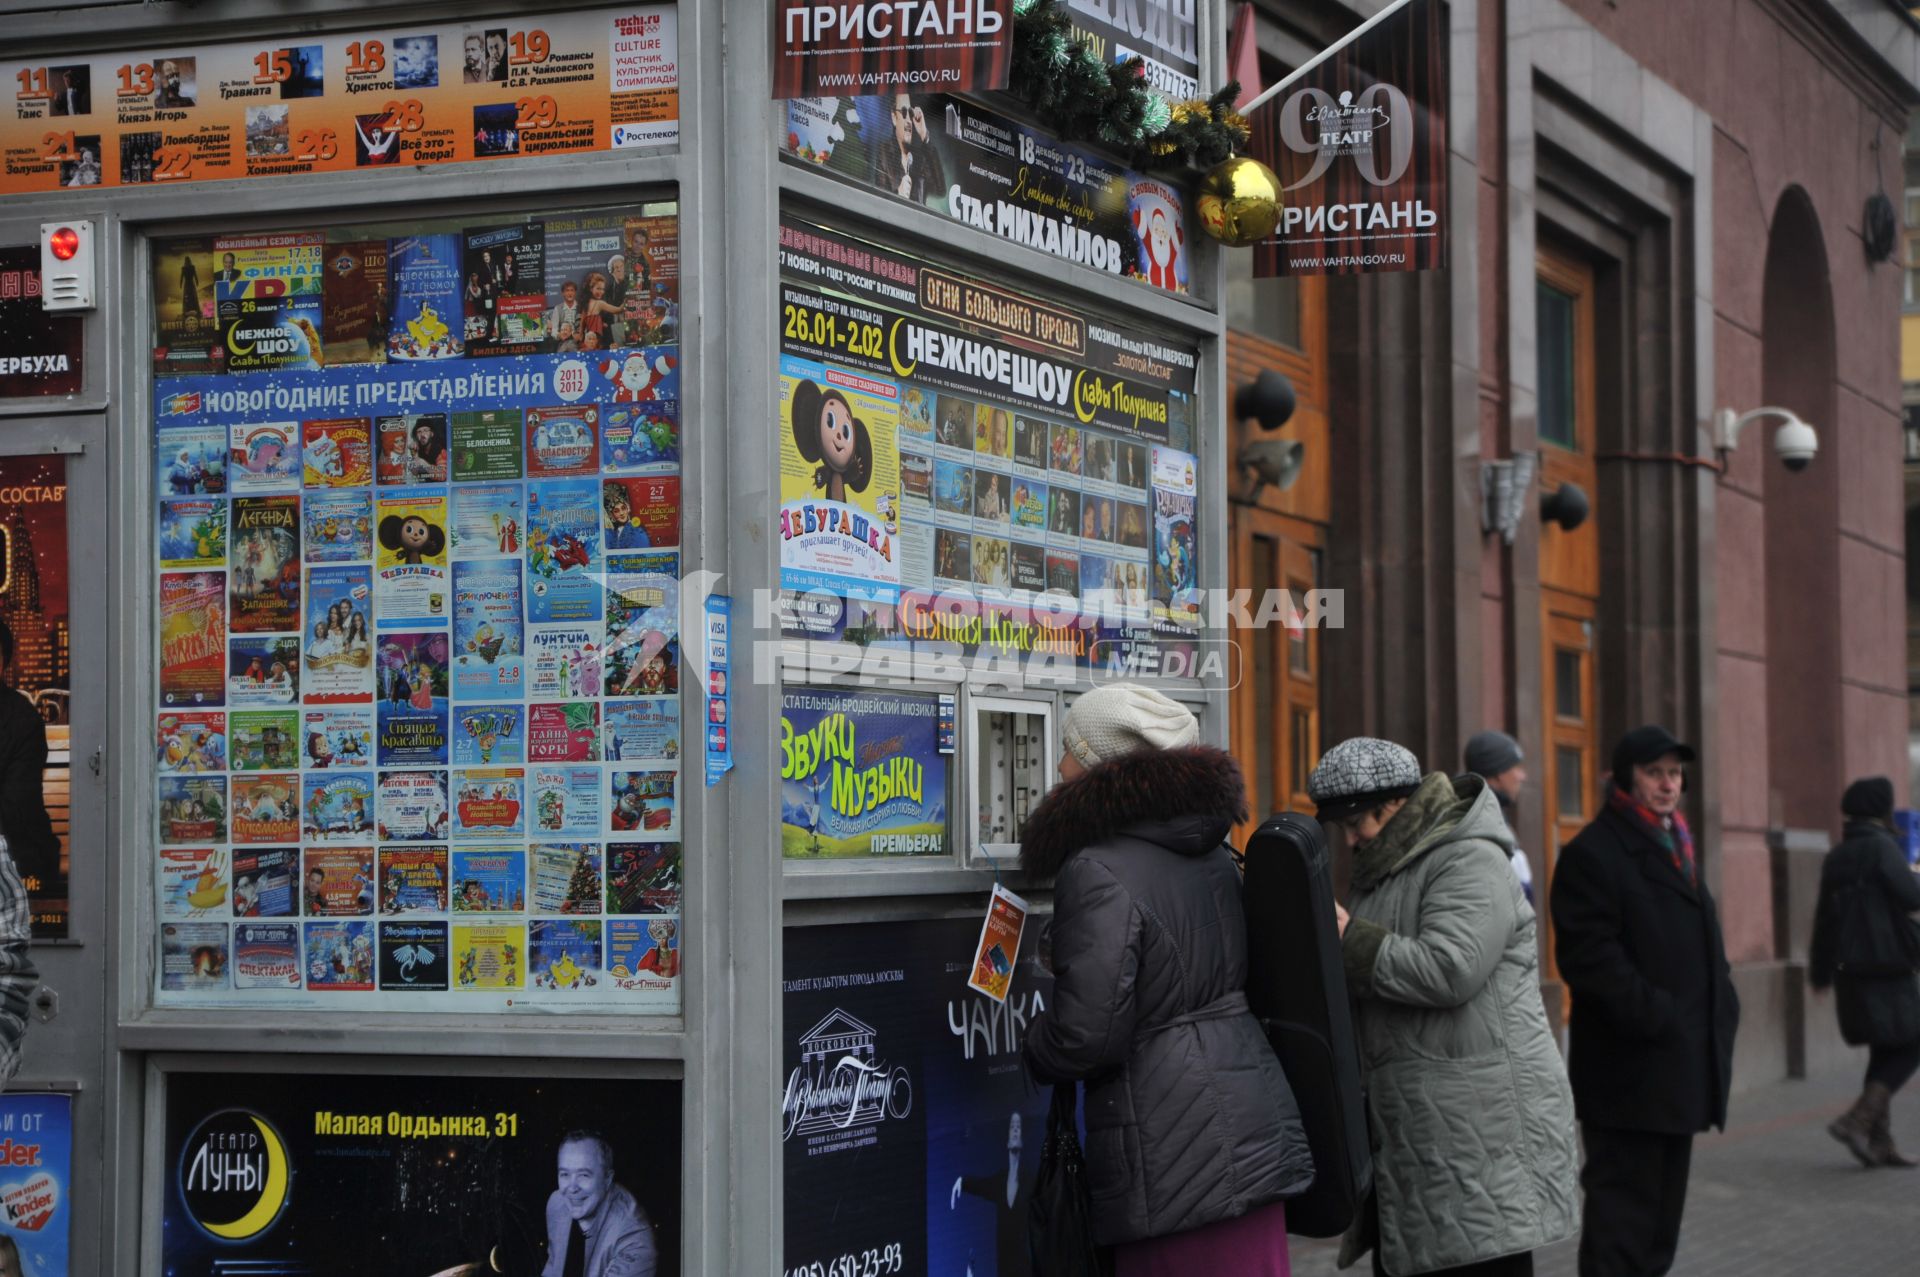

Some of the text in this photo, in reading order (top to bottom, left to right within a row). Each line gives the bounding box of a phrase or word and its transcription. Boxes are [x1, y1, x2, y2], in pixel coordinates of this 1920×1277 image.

[786, 0, 1002, 43] ПРИСТАНЬ
[510, 30, 551, 65] 19
[615, 39, 660, 53] CULTURE
[346, 40, 386, 73] 18
[549, 52, 594, 63] Романсы
[616, 54, 662, 66] УЧАСТНИК
[254, 50, 293, 83] 15
[532, 60, 594, 75] Чайковского
[616, 63, 675, 77] КУЛЬТУРНОЙ
[16, 67, 48, 93] 11
[117, 63, 155, 95] 13
[530, 72, 594, 86] Рахманинова
[617, 75, 677, 87] ОЛИМПИАДЫ
[819, 69, 961, 87] WWW.VAHTANGOV.RU
[220, 85, 271, 99] Травиата
[345, 80, 394, 94] Христос
[17, 108, 43, 120] Таис
[118, 110, 187, 124] Князь Игорь
[383, 99, 424, 131] 28
[515, 95, 557, 128] 29
[43, 130, 76, 156] 21
[164, 132, 231, 146] Ломбардцы
[521, 127, 594, 142] Севильский
[627, 130, 679, 142] Ростелеком
[1280, 83, 1413, 191] 90
[1320, 131, 1373, 145] ТЕАТР
[299, 128, 338, 161] 26
[400, 139, 445, 151] Всё это
[525, 139, 594, 153] цирюльник
[1019, 133, 1064, 164] 18 декабря
[414, 147, 455, 161] Опера!
[5, 163, 55, 175] Золушка
[153, 150, 192, 177] 22
[247, 162, 313, 176] Хованщина
[1067, 154, 1085, 185] 23
[1086, 164, 1113, 184] декабря
[216, 237, 267, 249] ЮБИЛЕЙНЫЙ
[270, 236, 295, 246] СЕЗОН
[998, 200, 1123, 274] МИХАЙЛОВ
[1290, 253, 1405, 268] WWW.VAHTANGOV.RU
[245, 264, 322, 277] ФИНАЛ
[873, 256, 916, 286] ПОКАЗЫ
[787, 254, 820, 275] НОЯБРЯ
[881, 284, 916, 305] ЛУЖНИКАХ
[241, 299, 293, 313] 26 2
[785, 290, 823, 311] МУЗЫКАЛЬНЫЙ
[824, 299, 839, 314] ТЕАТР
[872, 314, 883, 327] САЦ
[927, 277, 1080, 348] ОГНИ БОЛЬШОГО ГОРОДА
[256, 339, 300, 354] ШОУ
[1089, 325, 1121, 348] МЮЗИКЛ
[1144, 341, 1161, 361] ИЛЬИ
[1162, 346, 1194, 368] АВЕРБУХА
[1118, 353, 1147, 374] ЗОЛОТОЙ
[560, 369, 583, 382] 2011
[206, 384, 350, 414] НОВОГОДНИЕ
[356, 373, 545, 408] ПРЕДСТАВЛЕНИЯ
[560, 382, 584, 394] 2012
[1112, 382, 1167, 429] Полунина
[1, 486, 66, 503] СОСТАВ
[238, 507, 293, 529] ЛЕГЕНДА
[800, 534, 869, 559] приглашает друзей!
[456, 592, 519, 601] ПРИКЛЮЧЕНИЯ
[817, 603, 839, 617] ЛЬДУ
[710, 622, 725, 635] VISA
[903, 597, 1086, 658] Спящая Красавица
[533, 633, 590, 645] ЛУНТИКА
[712, 646, 725, 658] VISA
[499, 667, 519, 678] 2-8
[842, 697, 900, 717] БРОДВЕЙСКИЙ
[901, 703, 937, 717] МЮЗИКЛ!
[531, 729, 569, 738] ТАЙНА
[531, 745, 569, 755] ГОРЫ
[233, 817, 297, 836] Лукоморье
[831, 815, 862, 833] ВЕЛИКАЯ
[871, 834, 942, 853] ПРЕМЬЕРА!
[615, 978, 672, 990] Жар-Птица
[813, 970, 904, 989] КУЛЬТУРЫ ГОРОДА МОСКВЫ
[808, 1035, 869, 1052] МОСКОВСКИЙ
[22, 1113, 43, 1132] ОТ
[315, 1111, 518, 1138] Малая Ордынка, 31
[209, 1132, 258, 1151] ТЕАТР
[7, 1193, 52, 1220] Kinder
[828, 1242, 902, 1277] 650-23-93
